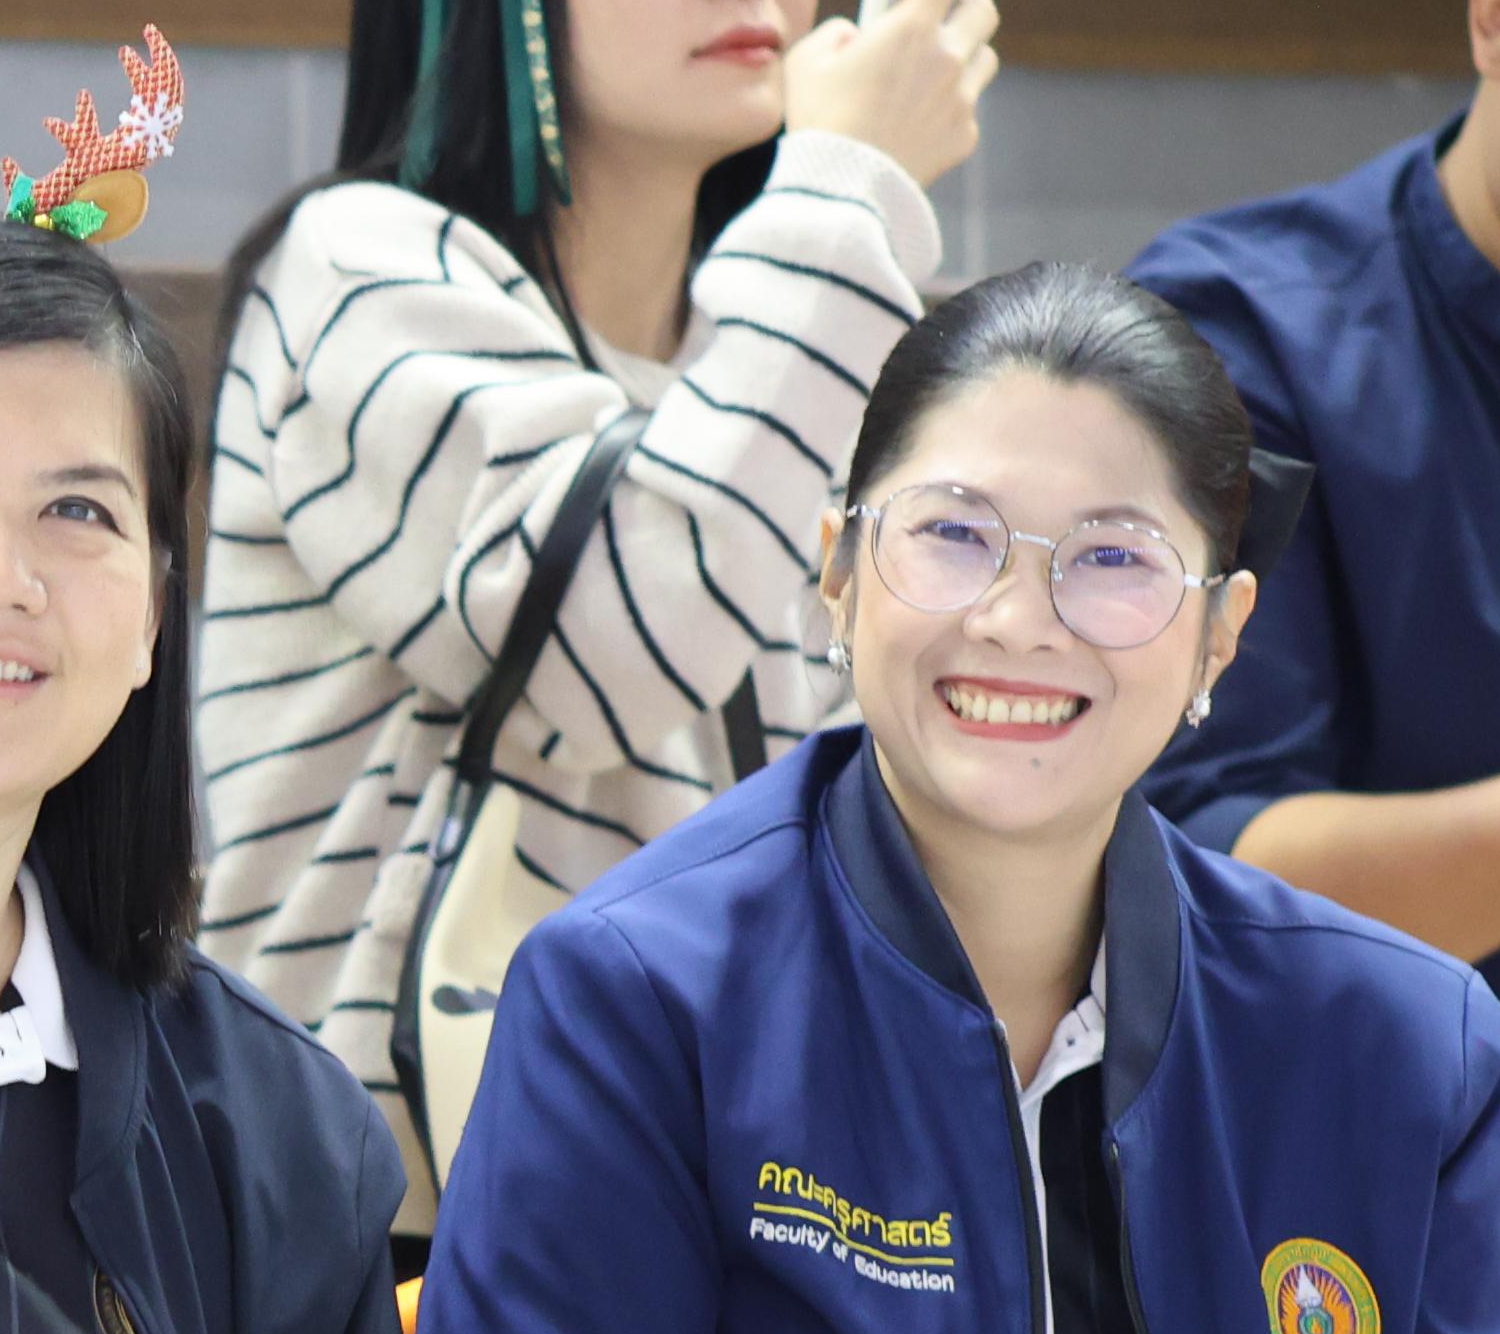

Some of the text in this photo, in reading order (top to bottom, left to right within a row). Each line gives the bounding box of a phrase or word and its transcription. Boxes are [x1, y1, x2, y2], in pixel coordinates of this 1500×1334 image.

[758, 1161, 952, 1247] คณะครุศาสตร์
[749, 1216, 955, 1294] Faculty of Education
